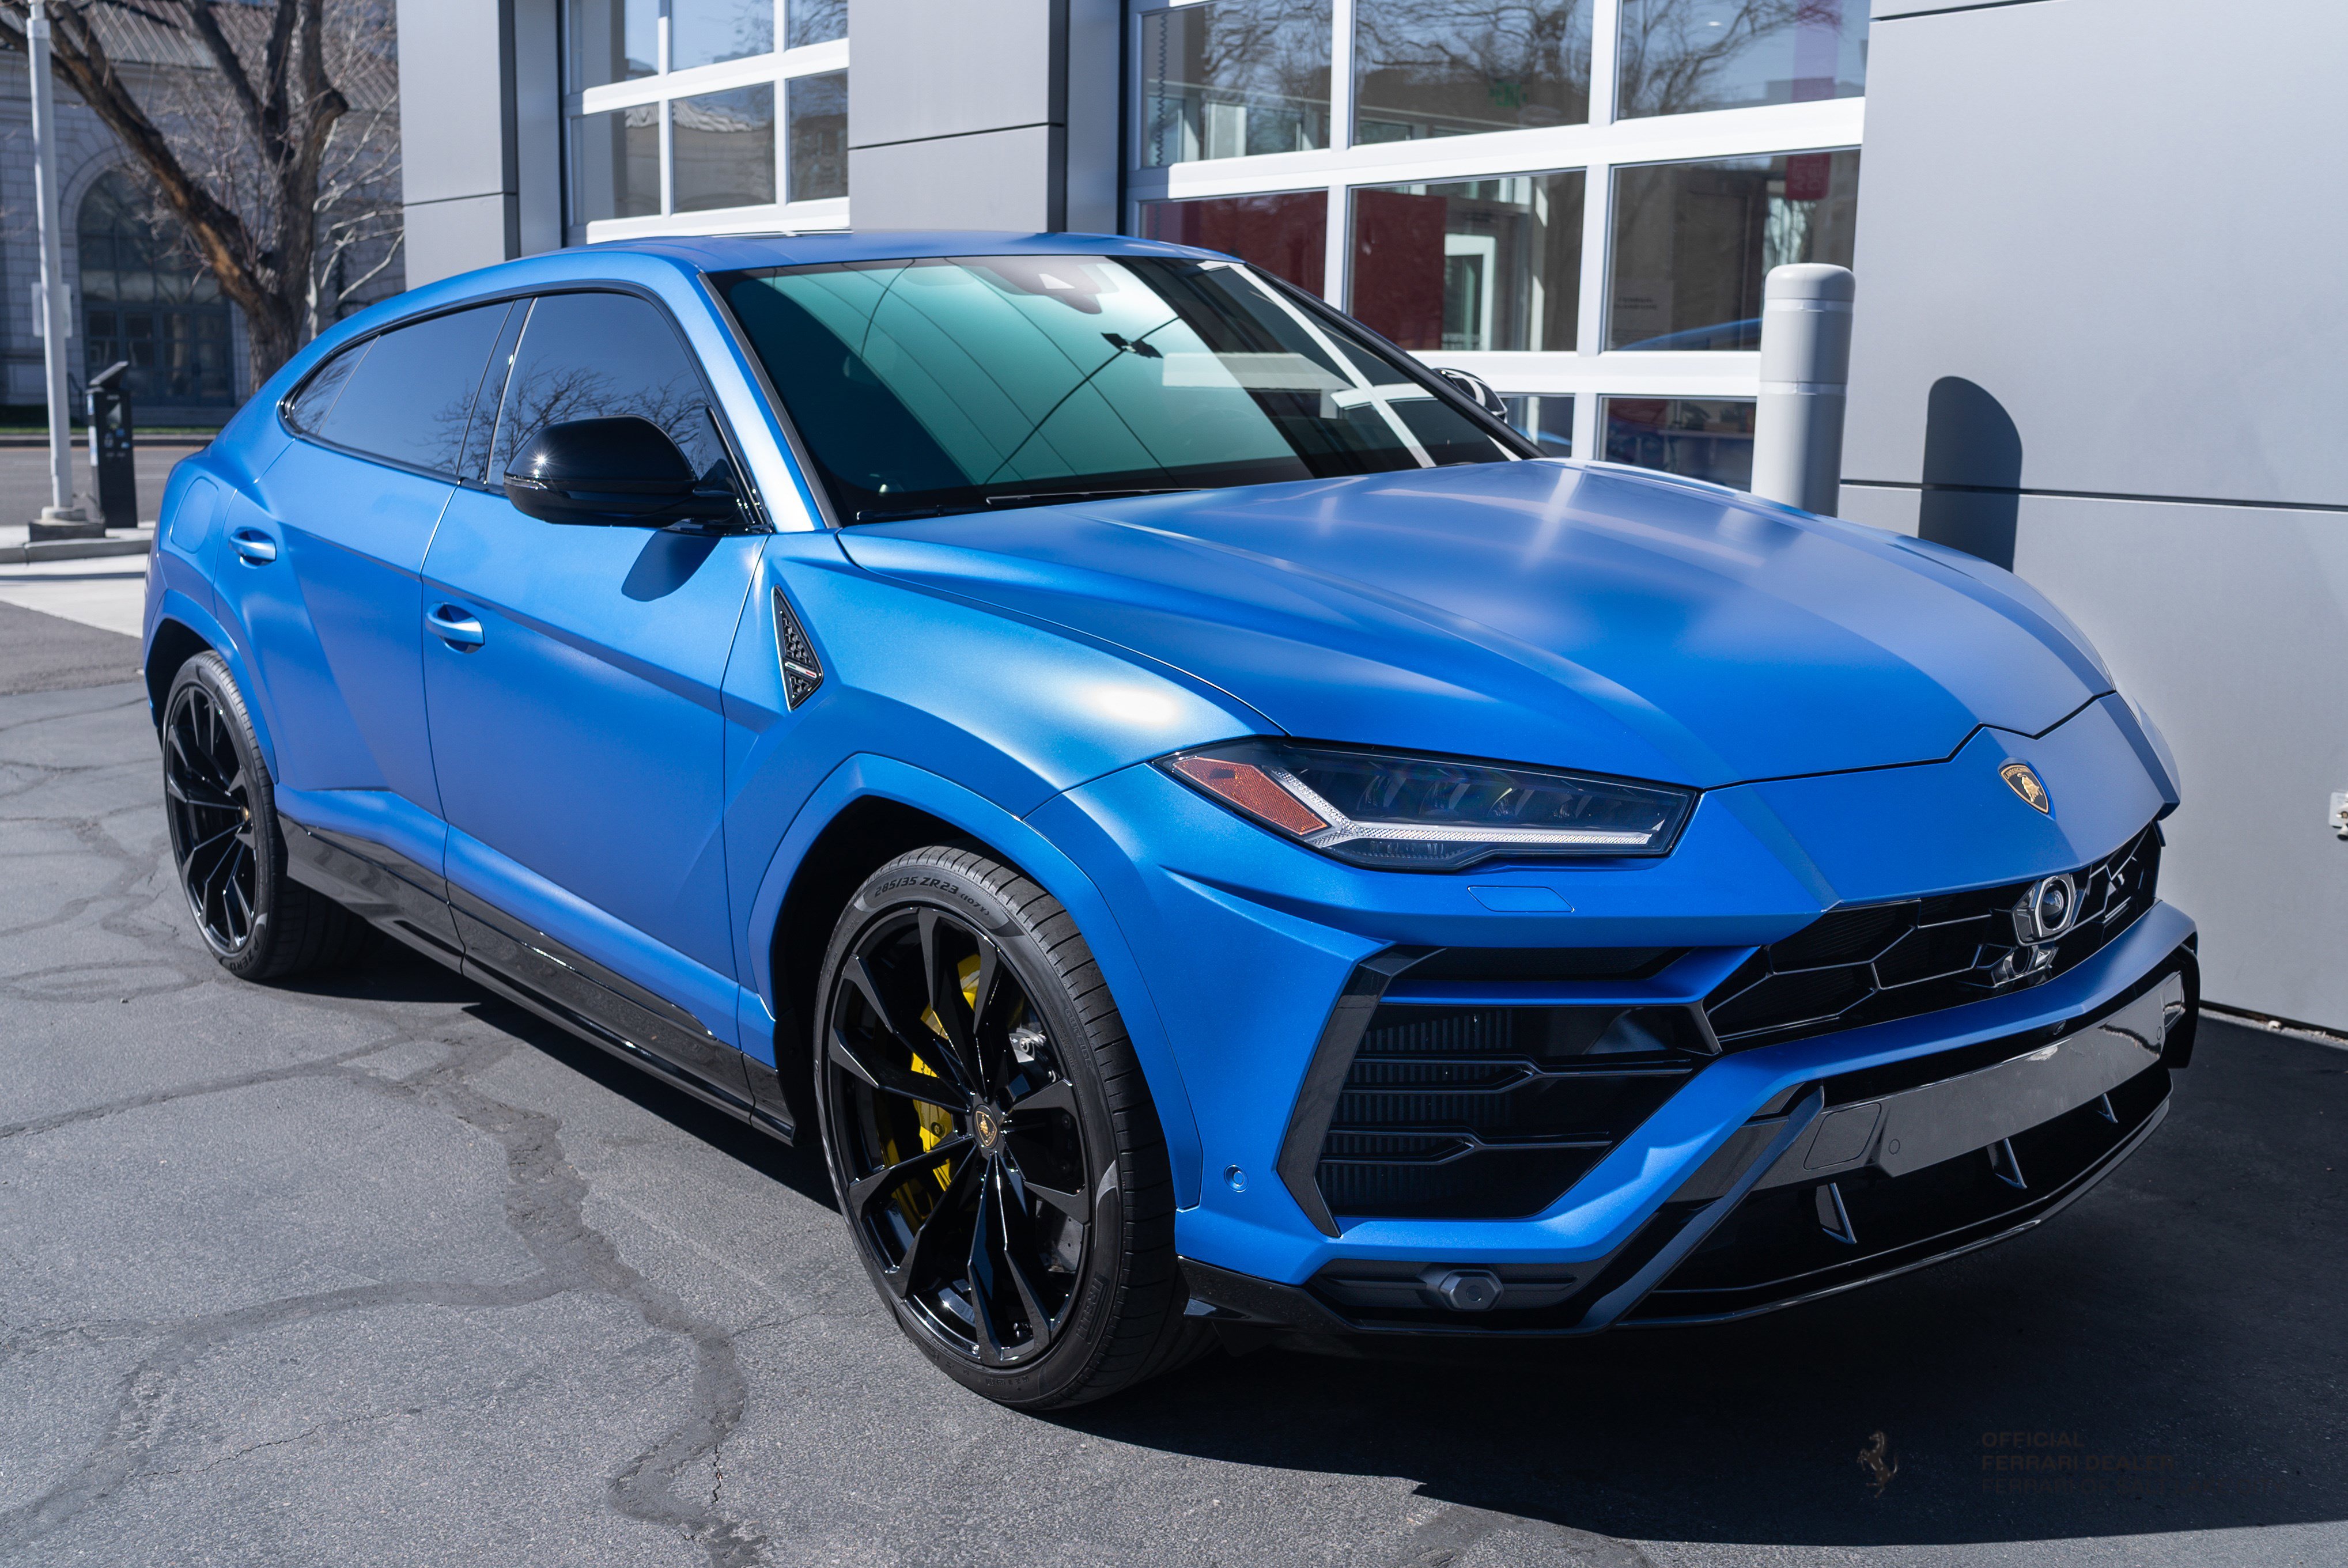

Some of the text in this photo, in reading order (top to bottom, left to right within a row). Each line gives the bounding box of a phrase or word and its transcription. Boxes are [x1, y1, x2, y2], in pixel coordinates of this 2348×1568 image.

[874, 876, 991, 917] 285/35 ZR23 (107Y)
[229, 948, 254, 971] ZERO
[1064, 1007, 1093, 1070] OUTSIDE
